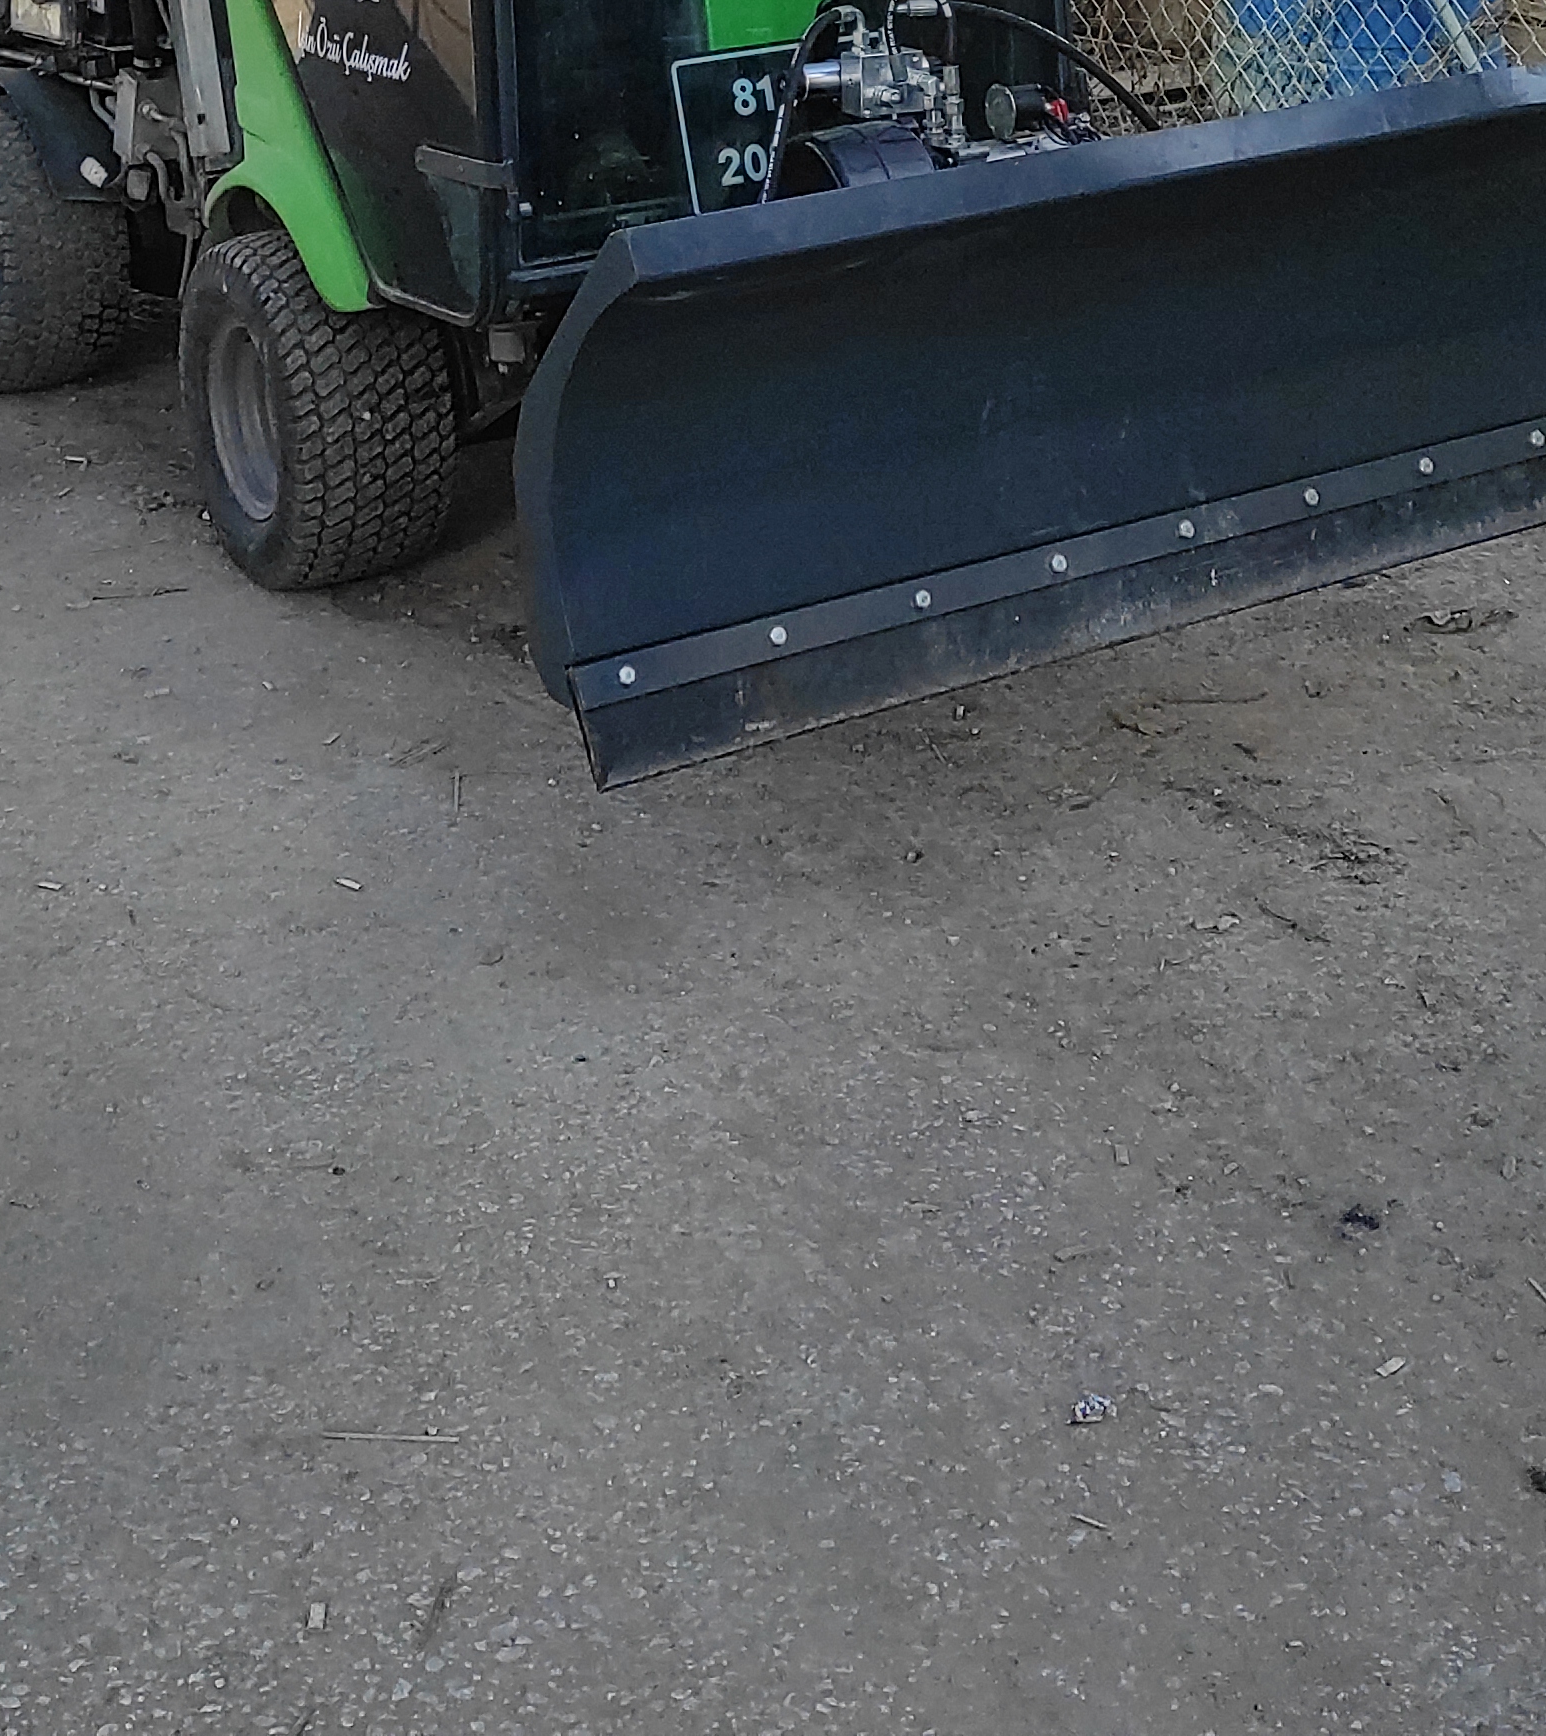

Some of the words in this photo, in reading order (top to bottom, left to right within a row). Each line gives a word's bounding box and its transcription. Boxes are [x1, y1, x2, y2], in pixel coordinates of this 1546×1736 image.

[316, 16, 342, 64] Özü
[342, 32, 412, 82] Çalışmak
[732, 73, 776, 117] 81
[717, 143, 768, 187] 20
